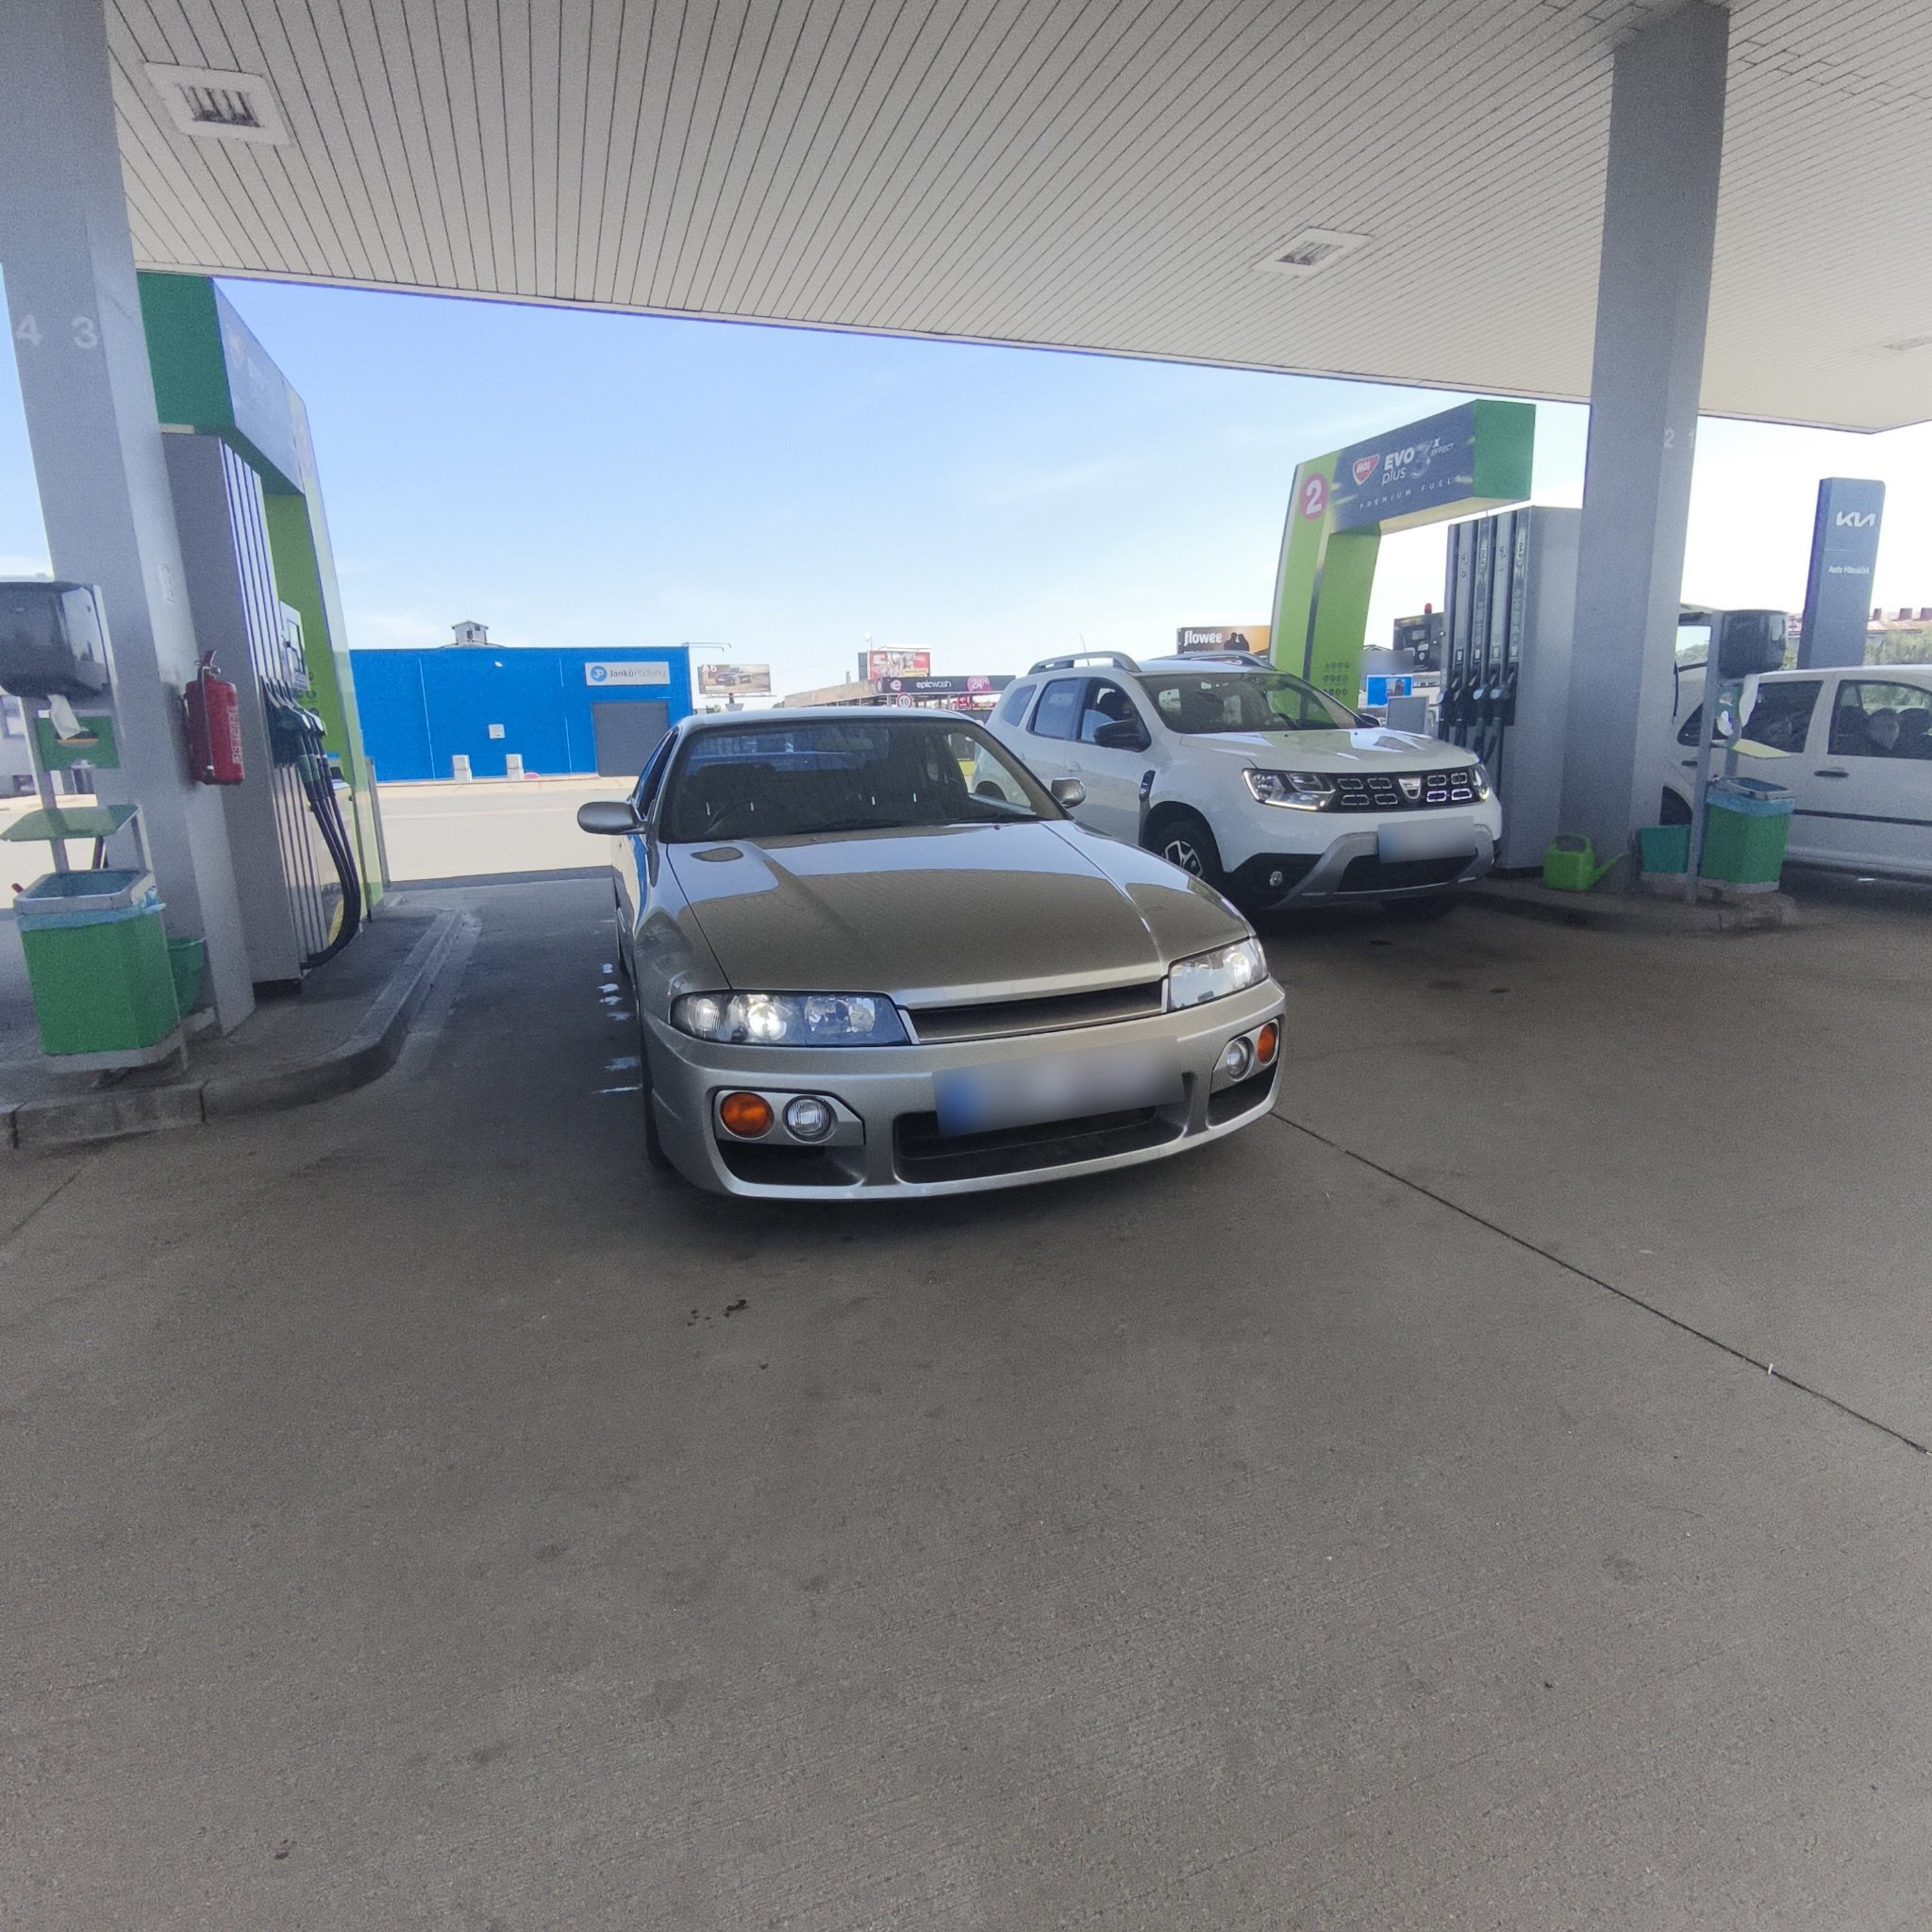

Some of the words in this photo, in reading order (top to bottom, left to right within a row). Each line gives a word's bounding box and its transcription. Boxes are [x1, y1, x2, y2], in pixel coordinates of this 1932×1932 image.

[16, 313, 43, 347] 4
[71, 315, 98, 349] 3
[1663, 427, 1675, 448] 2
[1384, 446, 1416, 471] EVO
[1430, 442, 1455, 458] EFFECT
[1381, 466, 1407, 487] plus
[1306, 479, 1322, 515] 2
[1359, 489, 1412, 509] PREMIUM
[1836, 510, 1876, 527] KIA
[1183, 630, 1224, 647] flowee
[916, 680, 952, 690] epicwash
